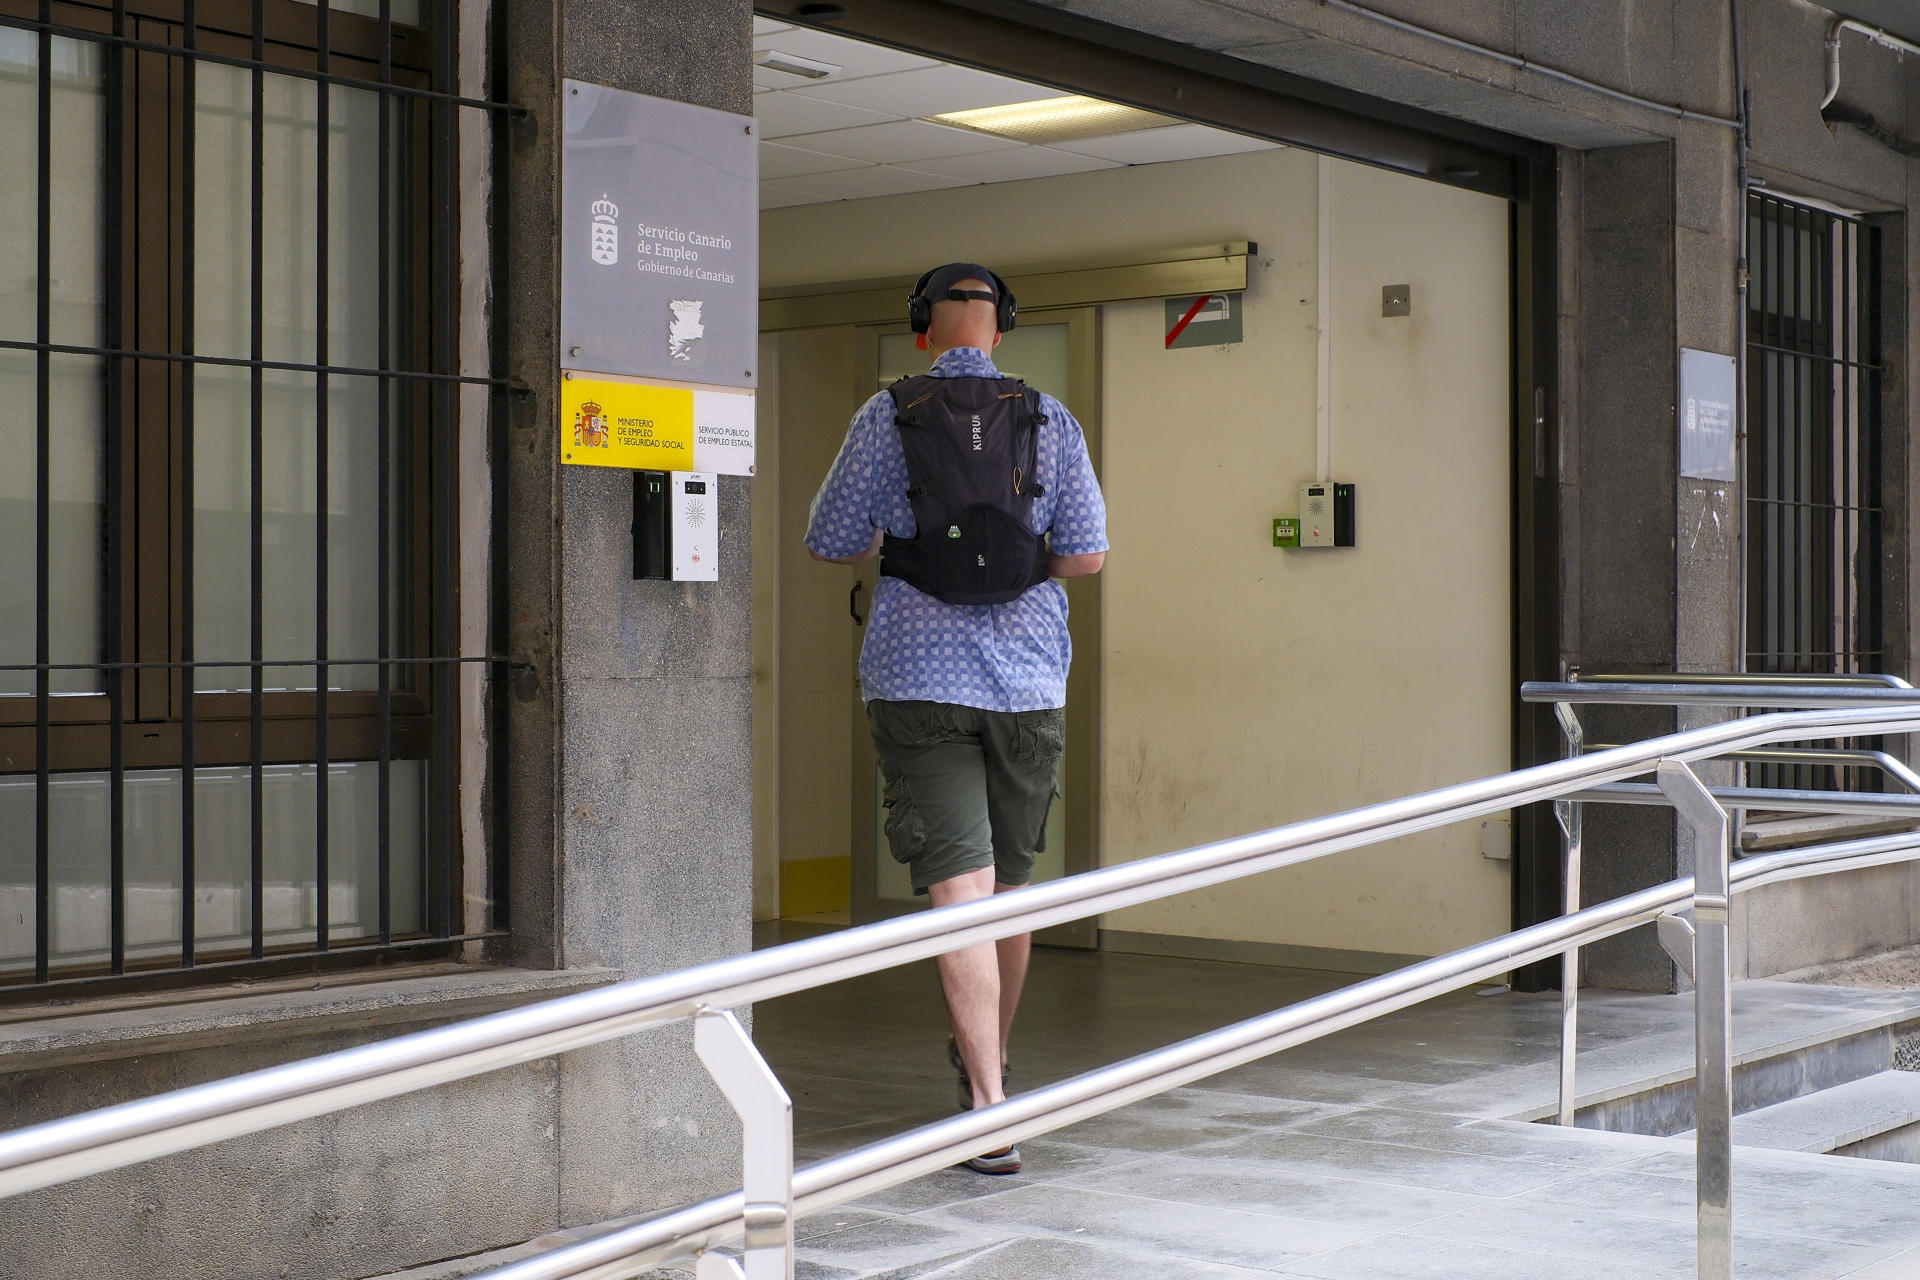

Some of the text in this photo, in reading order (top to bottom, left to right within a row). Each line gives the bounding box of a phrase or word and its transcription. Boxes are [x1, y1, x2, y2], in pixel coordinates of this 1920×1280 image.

[638, 223, 732, 250] Servicio Canario
[637, 240, 698, 261] de Empleo
[637, 260, 735, 284] Gobierno de Canarias
[617, 417, 654, 428] MINISTERIO
[617, 427, 653, 438] DE EMPLEO
[698, 426, 750, 438] SERVICIO PÚBLICO
[617, 437, 685, 450] Y SEGURIDAD SOCIAL
[698, 436, 753, 448] DE EMPLEO ESTATAL
